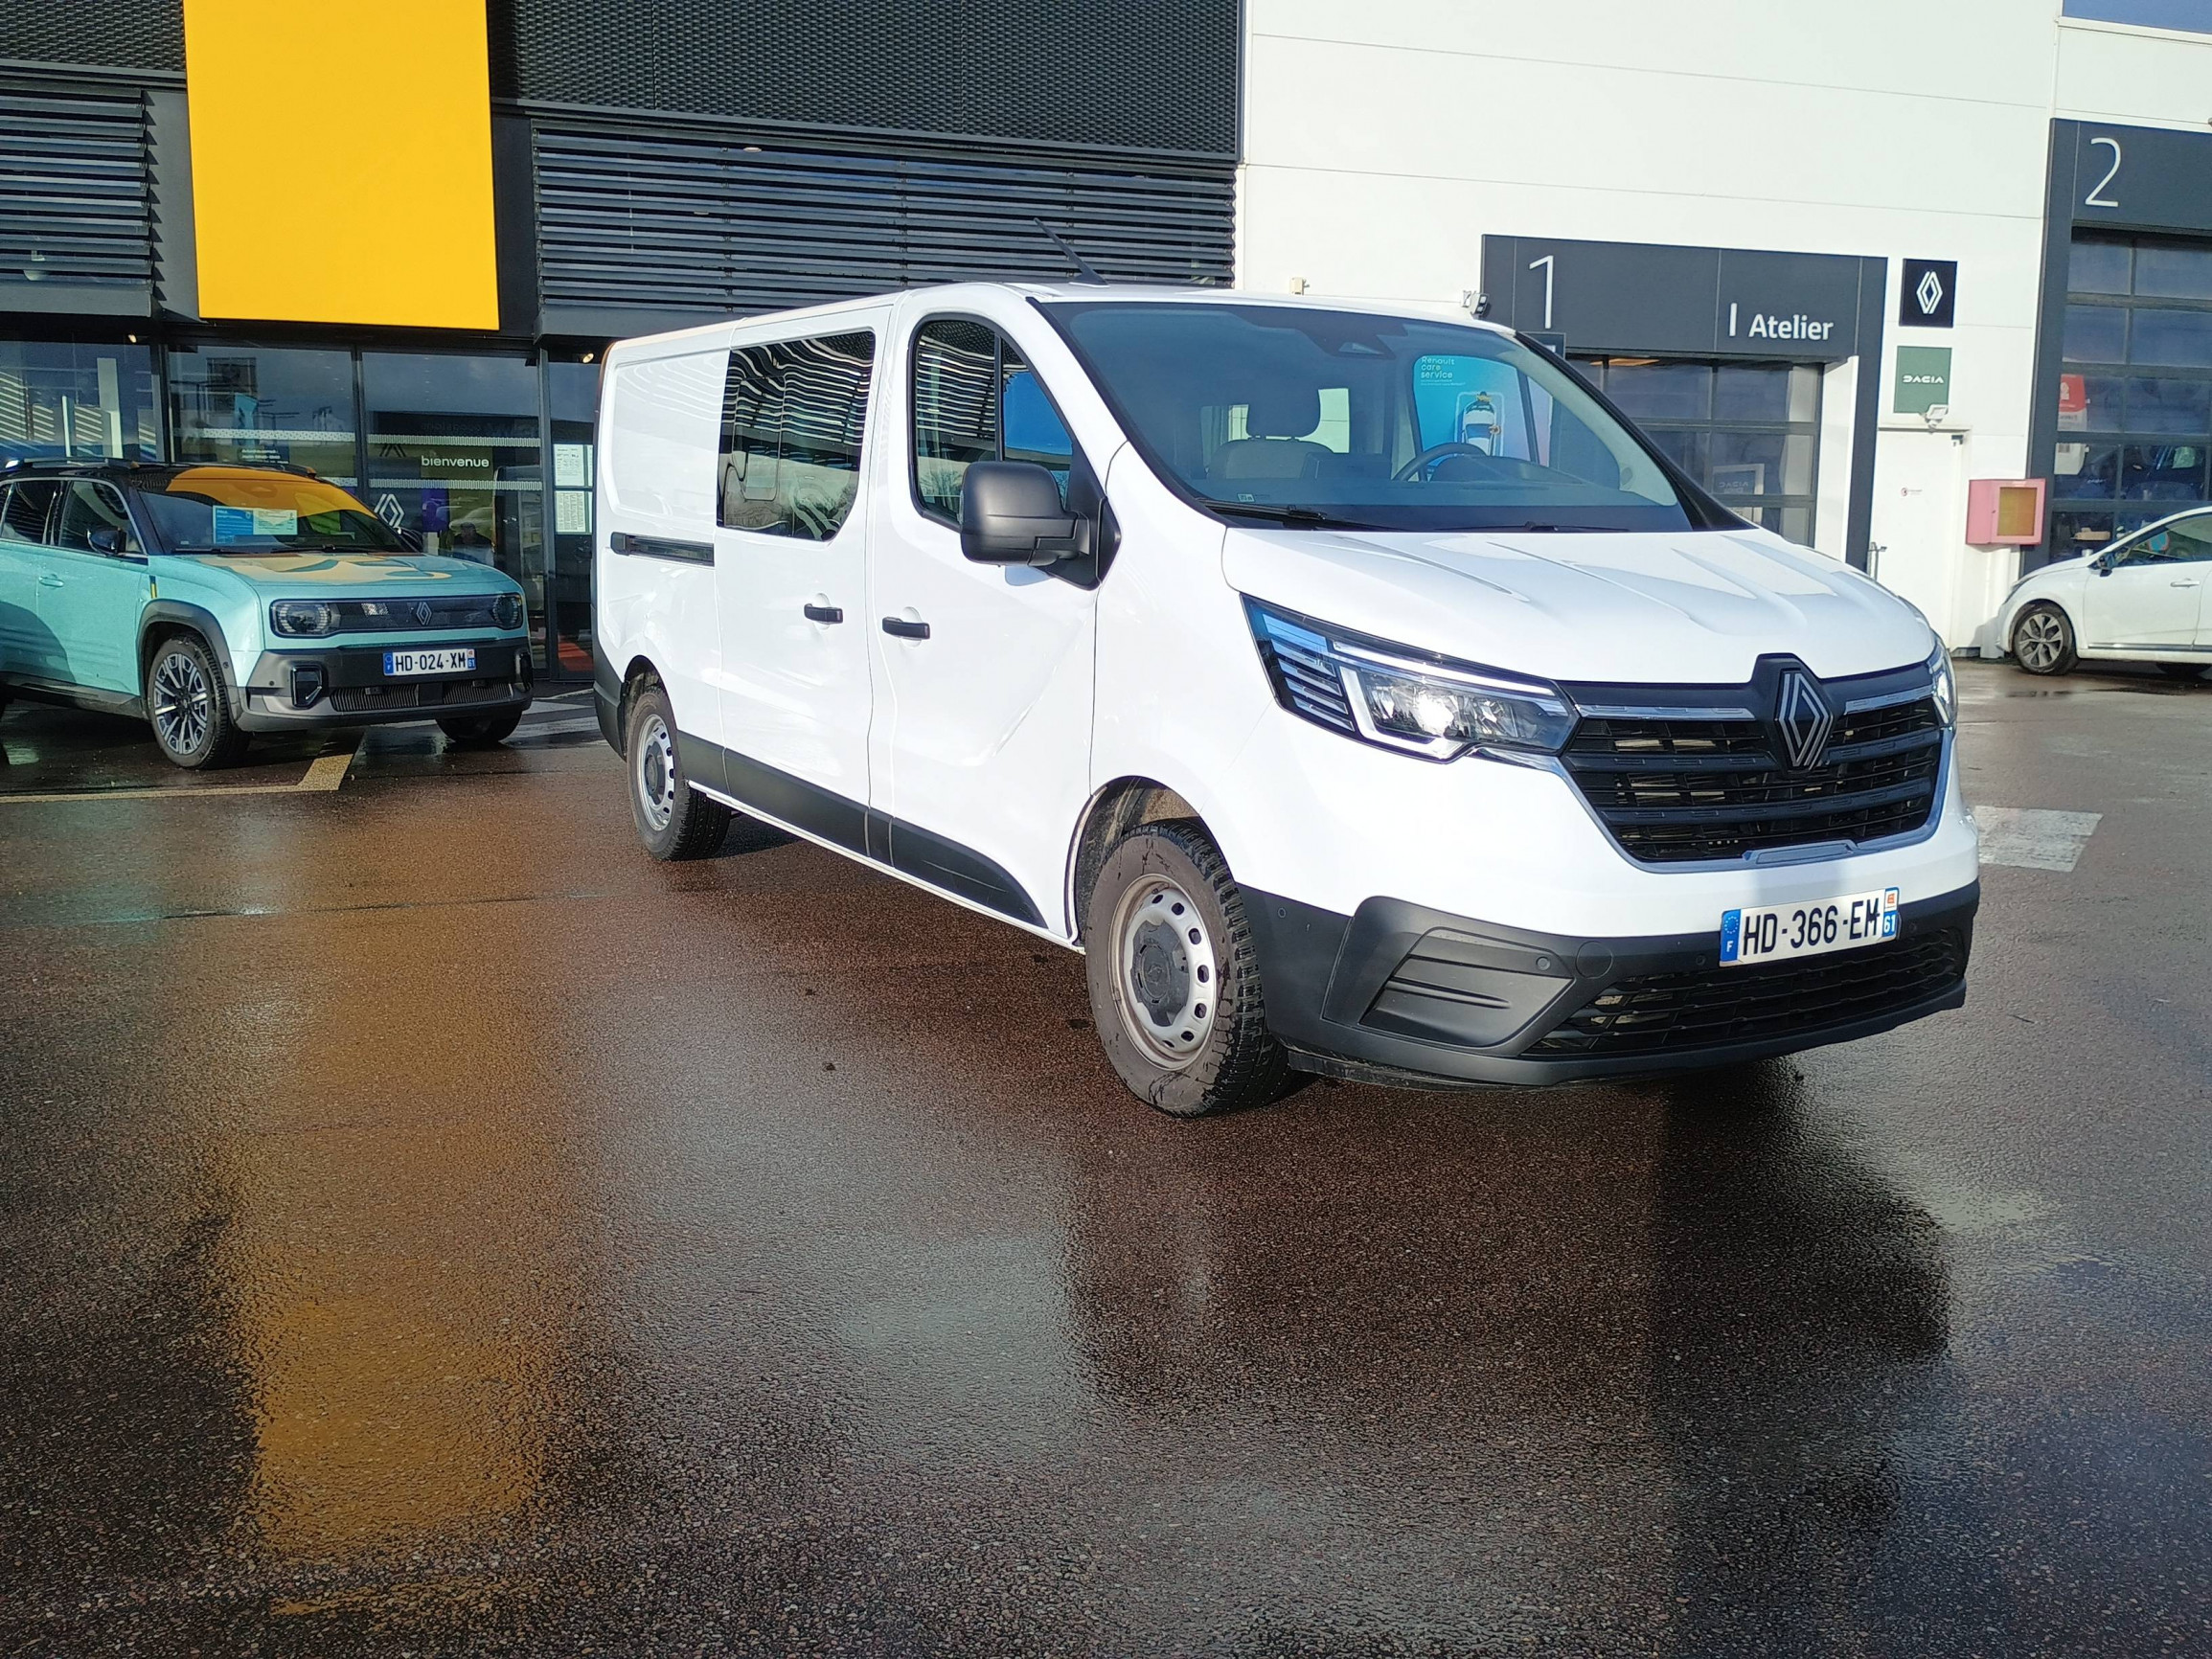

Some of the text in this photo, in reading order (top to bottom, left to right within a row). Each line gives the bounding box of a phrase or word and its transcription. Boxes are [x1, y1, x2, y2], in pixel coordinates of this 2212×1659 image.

[2085, 137, 2122, 208] 2
[1529, 255, 1554, 330] 1
[1748, 313, 1834, 340] Atelier
[1903, 375, 1945, 384] DACIA
[421, 455, 490, 467] bienvenue
[396, 652, 466, 671] HD-024-XM
[1726, 940, 1733, 952] F
[1743, 898, 1881, 956] HD-366-EM
[1883, 915, 1896, 933] 61
